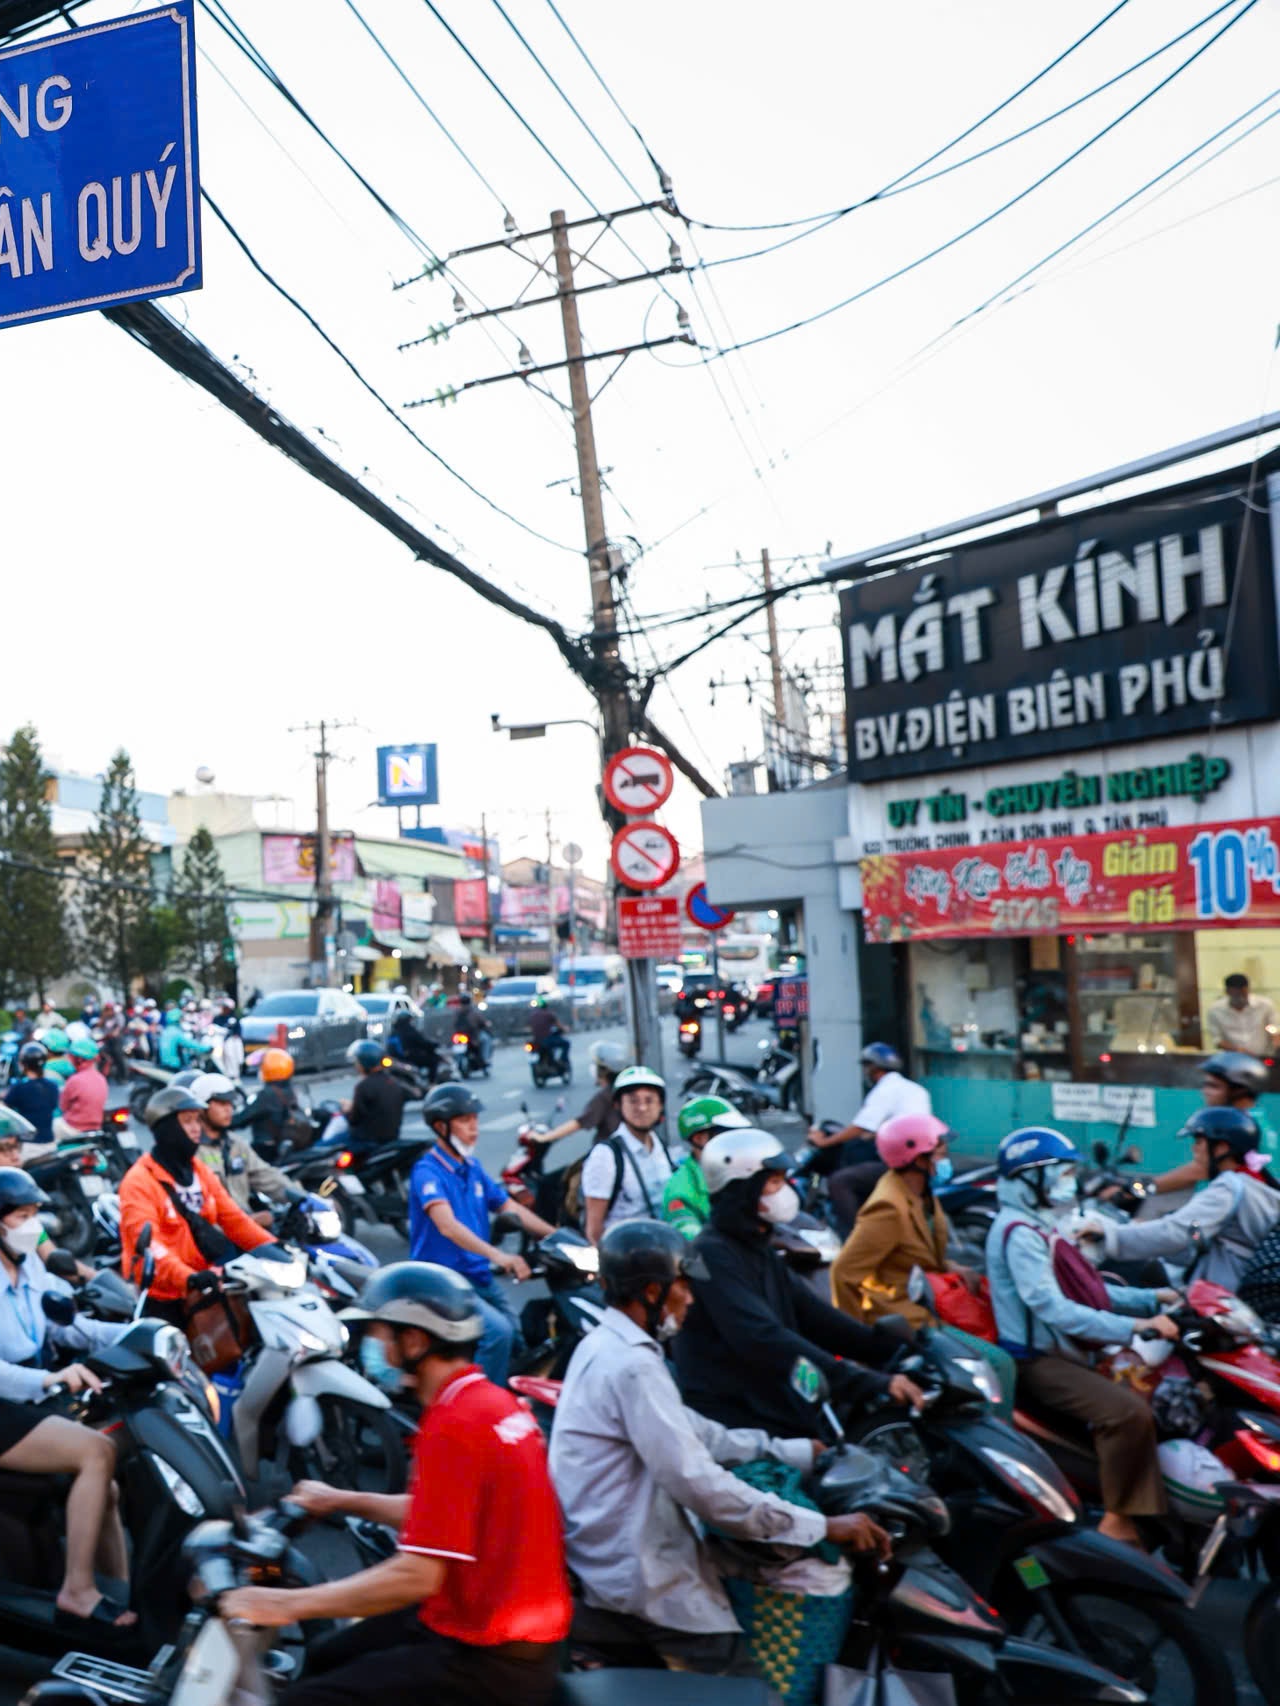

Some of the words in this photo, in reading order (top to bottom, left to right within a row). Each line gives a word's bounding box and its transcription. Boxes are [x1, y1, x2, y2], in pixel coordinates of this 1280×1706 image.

[77, 142, 177, 262] QUÝ
[848, 573, 995, 690] MẮT
[1017, 523, 1228, 651] KÍNH
[1006, 668, 1107, 737] BIÊN
[1118, 628, 1225, 716] PHỦ
[887, 800, 920, 828] UY
[1103, 833, 1177, 877] Giảm
[1127, 884, 1175, 925] Giá
